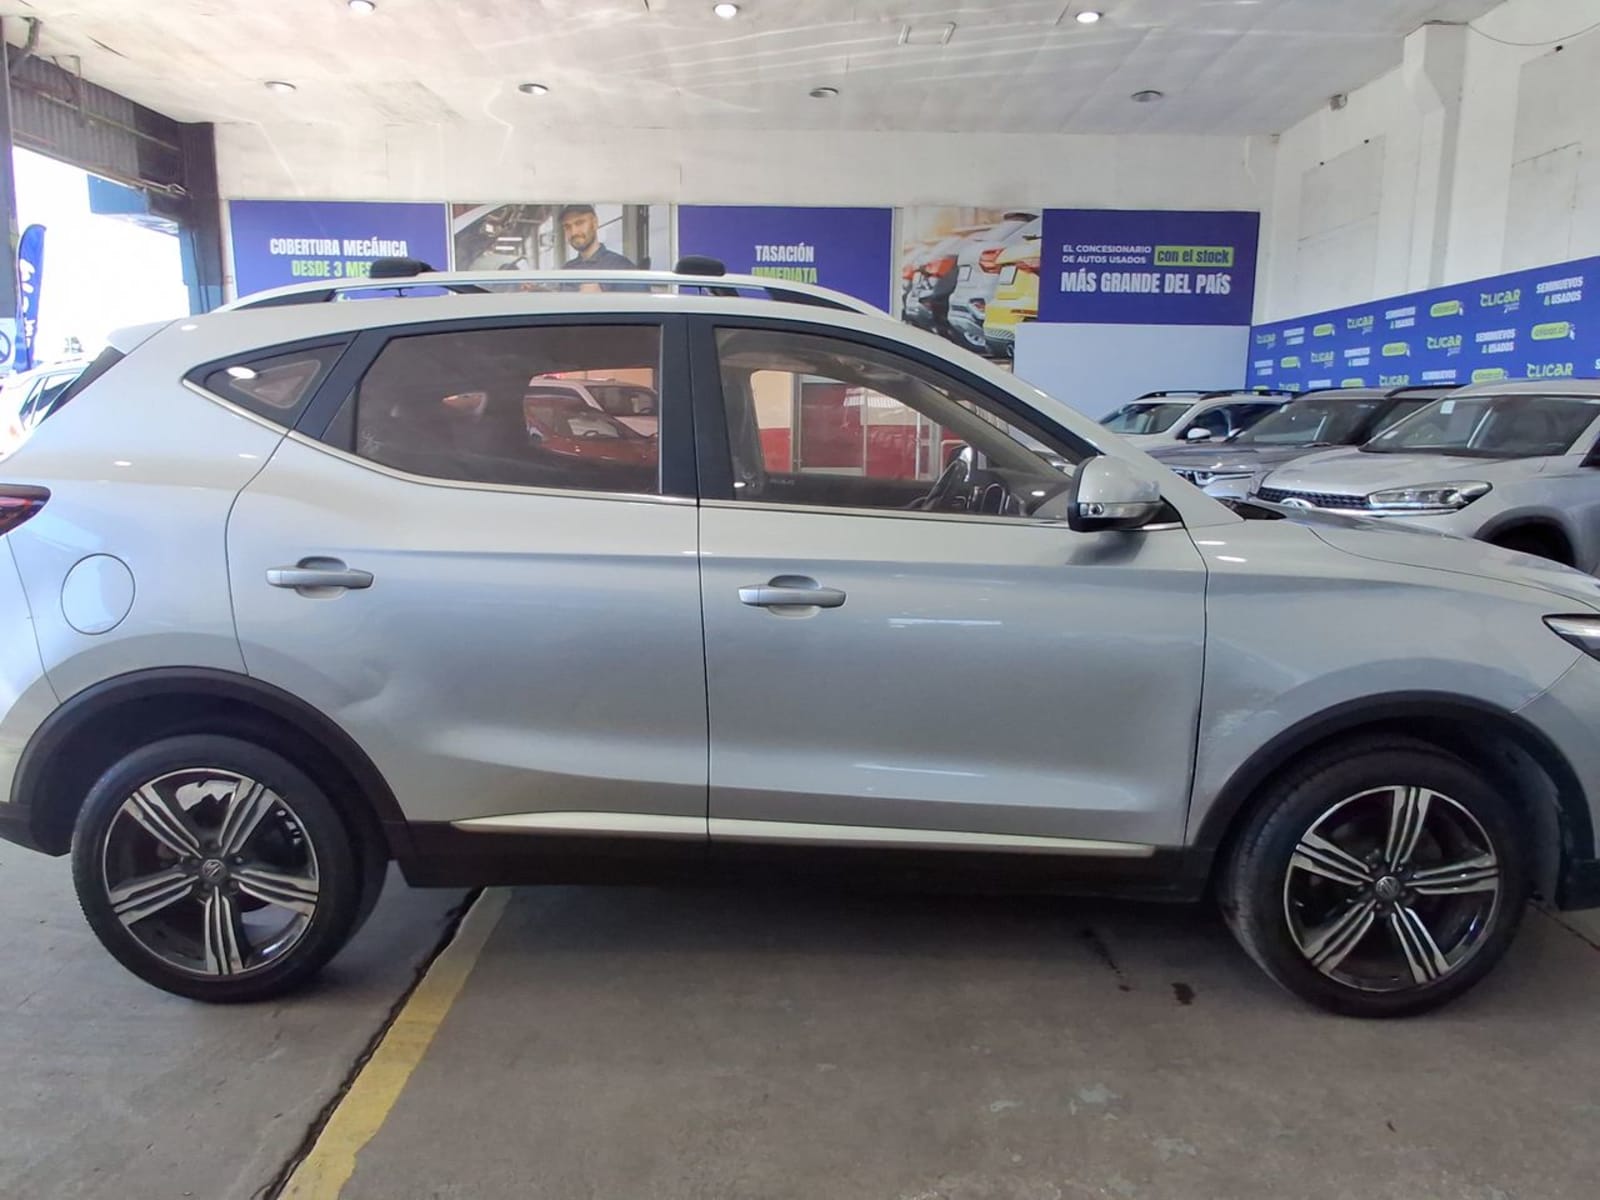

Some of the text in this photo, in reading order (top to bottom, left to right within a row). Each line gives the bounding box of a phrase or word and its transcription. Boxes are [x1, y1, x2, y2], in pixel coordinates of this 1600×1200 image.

[270, 236, 408, 257] COBERTURA MECÁNICA
[754, 242, 815, 262] TASACIÓN
[1062, 244, 1230, 264] EL CONCESIONARIO con el stock
[291, 260, 331, 277] DESDE
[333, 261, 343, 277] 3
[1062, 255, 1147, 265] DE AUTOS USADOS
[1060, 267, 1232, 296] MÁS GRANDE DEL PAÍS
